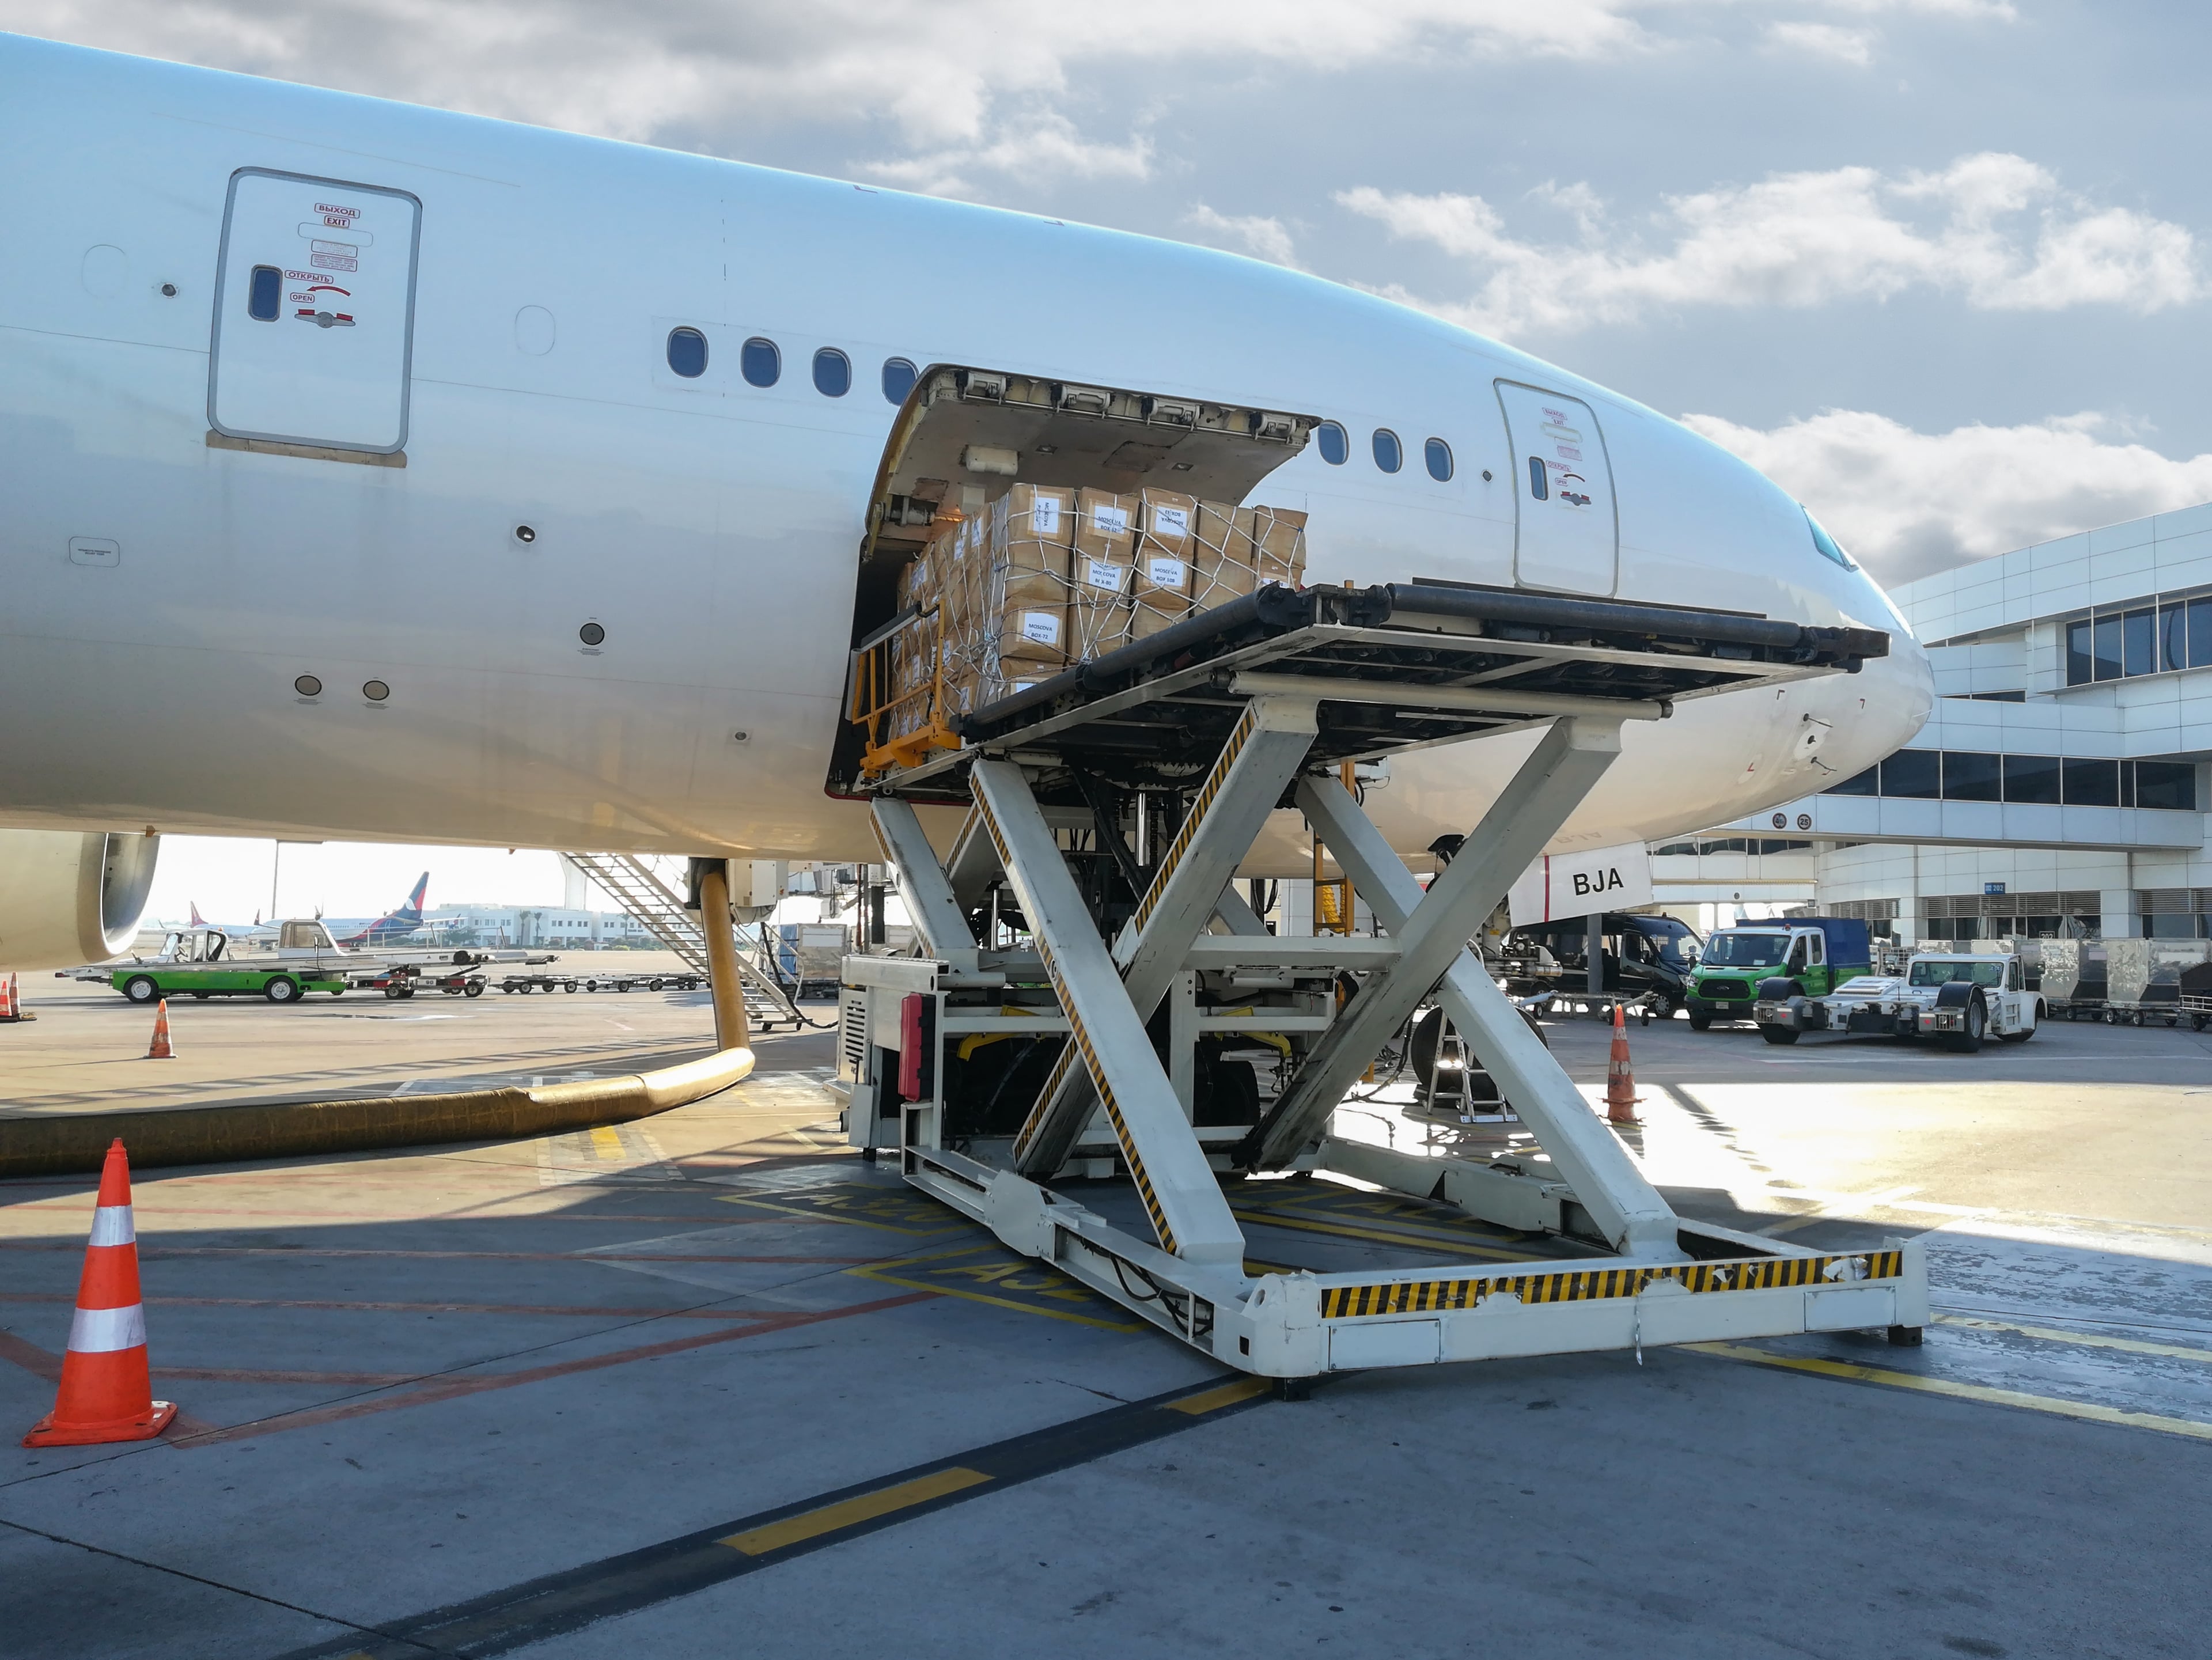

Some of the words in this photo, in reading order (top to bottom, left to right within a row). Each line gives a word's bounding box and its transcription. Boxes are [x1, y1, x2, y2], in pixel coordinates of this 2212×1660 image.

[319, 205, 355, 217] ВЫХОД
[327, 217, 347, 226] EXIT
[289, 272, 329, 282] ОТКРЫТЬ
[1028, 623, 1052, 631] MOSCOVA
[1573, 867, 1624, 896] BJA
